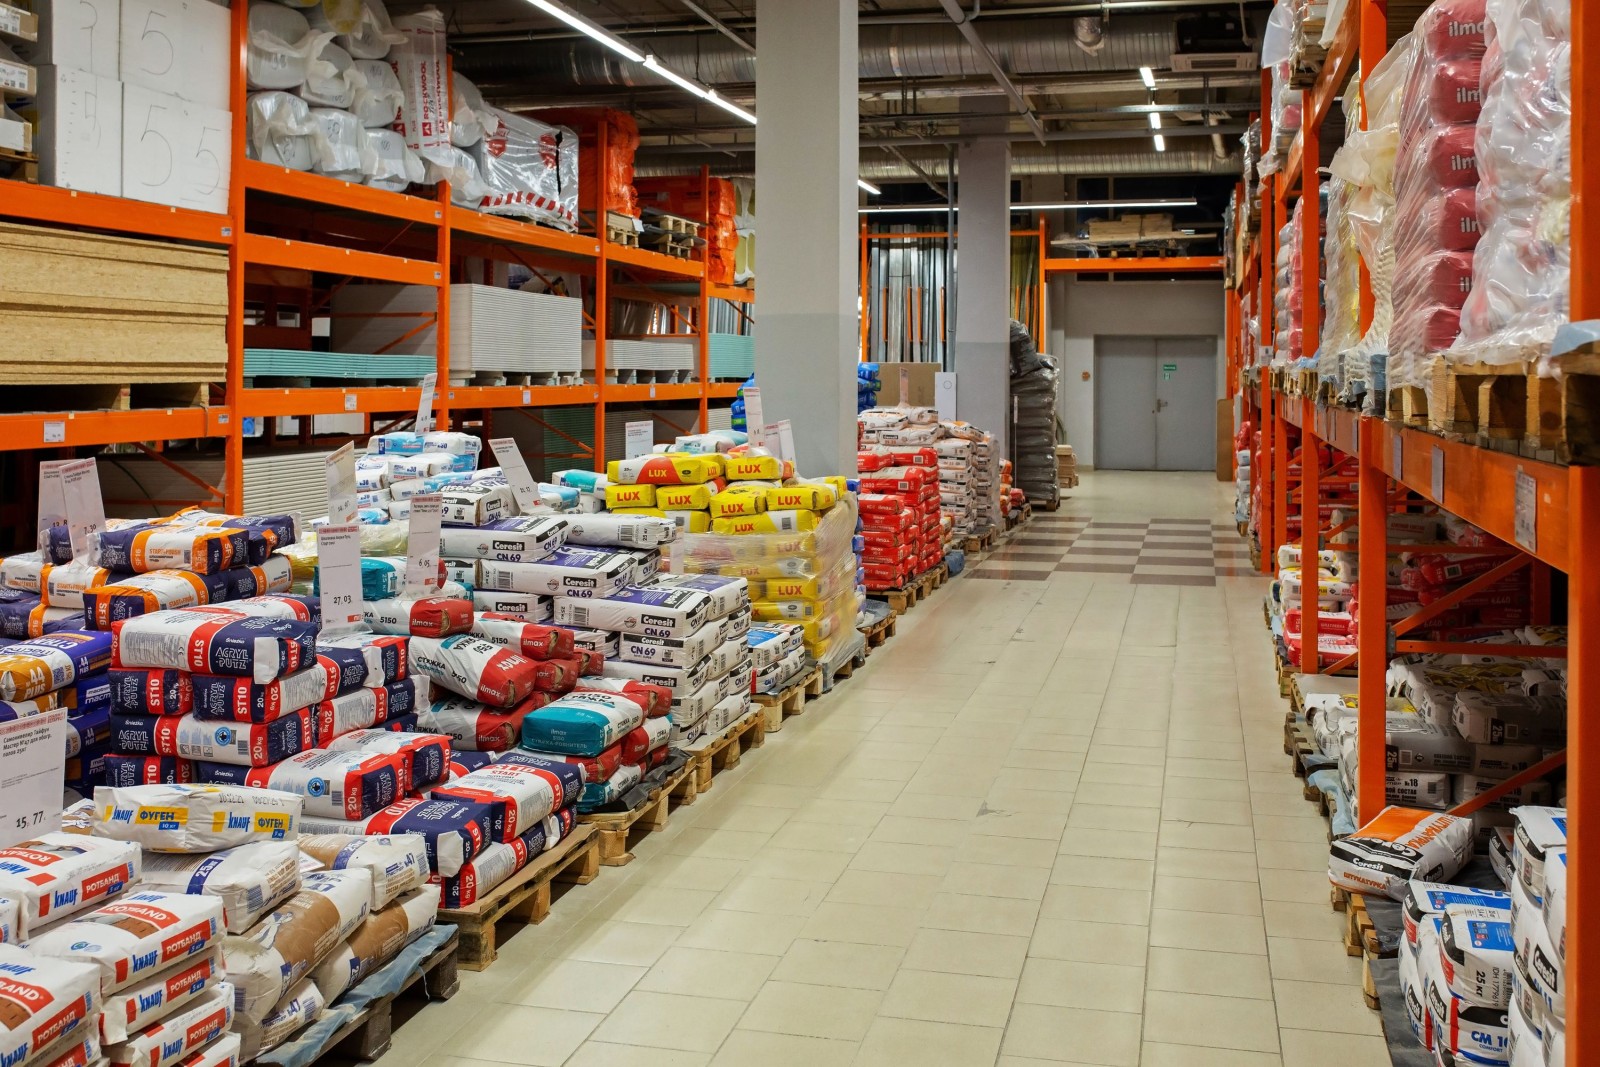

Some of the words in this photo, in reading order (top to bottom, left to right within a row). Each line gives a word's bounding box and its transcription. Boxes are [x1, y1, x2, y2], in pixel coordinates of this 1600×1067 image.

[648, 469, 667, 478] LUX
[737, 464, 761, 475] LUX
[616, 491, 640, 502] LUX
[668, 495, 692, 505] LUX
[777, 495, 801, 506] LUX
[721, 503, 744, 514] LUX
[734, 523, 754, 533] LUX
[494, 542, 523, 551] Ceresit
[565, 578, 595, 588] Ceresit
[778, 586, 803, 596] LUX
[98, 602, 108, 626] SF16
[497, 603, 526, 612] Ceresit
[643, 616, 674, 627] Ceresit
[523, 639, 543, 647] ilmax
[641, 637, 665, 646] Ceresit
[194, 639, 205, 667] ST10
[631, 645, 643, 654] CN
[645, 646, 656, 655] 69
[150, 678, 160, 706] ST10
[237, 686, 248, 715] ST10
[324, 710, 333, 724] 20
[254, 746, 264, 760] 20
[347, 797, 357, 811] 20
[112, 805, 134, 824] KNAUF
[140, 810, 174, 821] ФУГЕН
[228, 811, 250, 832] KNAUF
[258, 817, 284, 828] ФУГЕН
[508, 809, 516, 823] 20
[465, 874, 474, 889] 20
[54, 888, 78, 909] KNAUF
[86, 872, 120, 894] РОТБАНД
[452, 884, 460, 897] 20
[132, 949, 157, 973] KNAUF
[166, 931, 201, 955] РОТБАНД
[1476, 970, 1486, 985] 25
[139, 989, 162, 1013] KNAUF
[170, 970, 201, 994] РОТБАНД
[37, 1012, 76, 1043] РОТБАНД
[162, 1037, 183, 1060] KNAUF
[190, 1018, 219, 1041] РОТБАНД
[1471, 1030, 1493, 1046] CM
[1479, 1044, 1503, 1053] COMFORT
